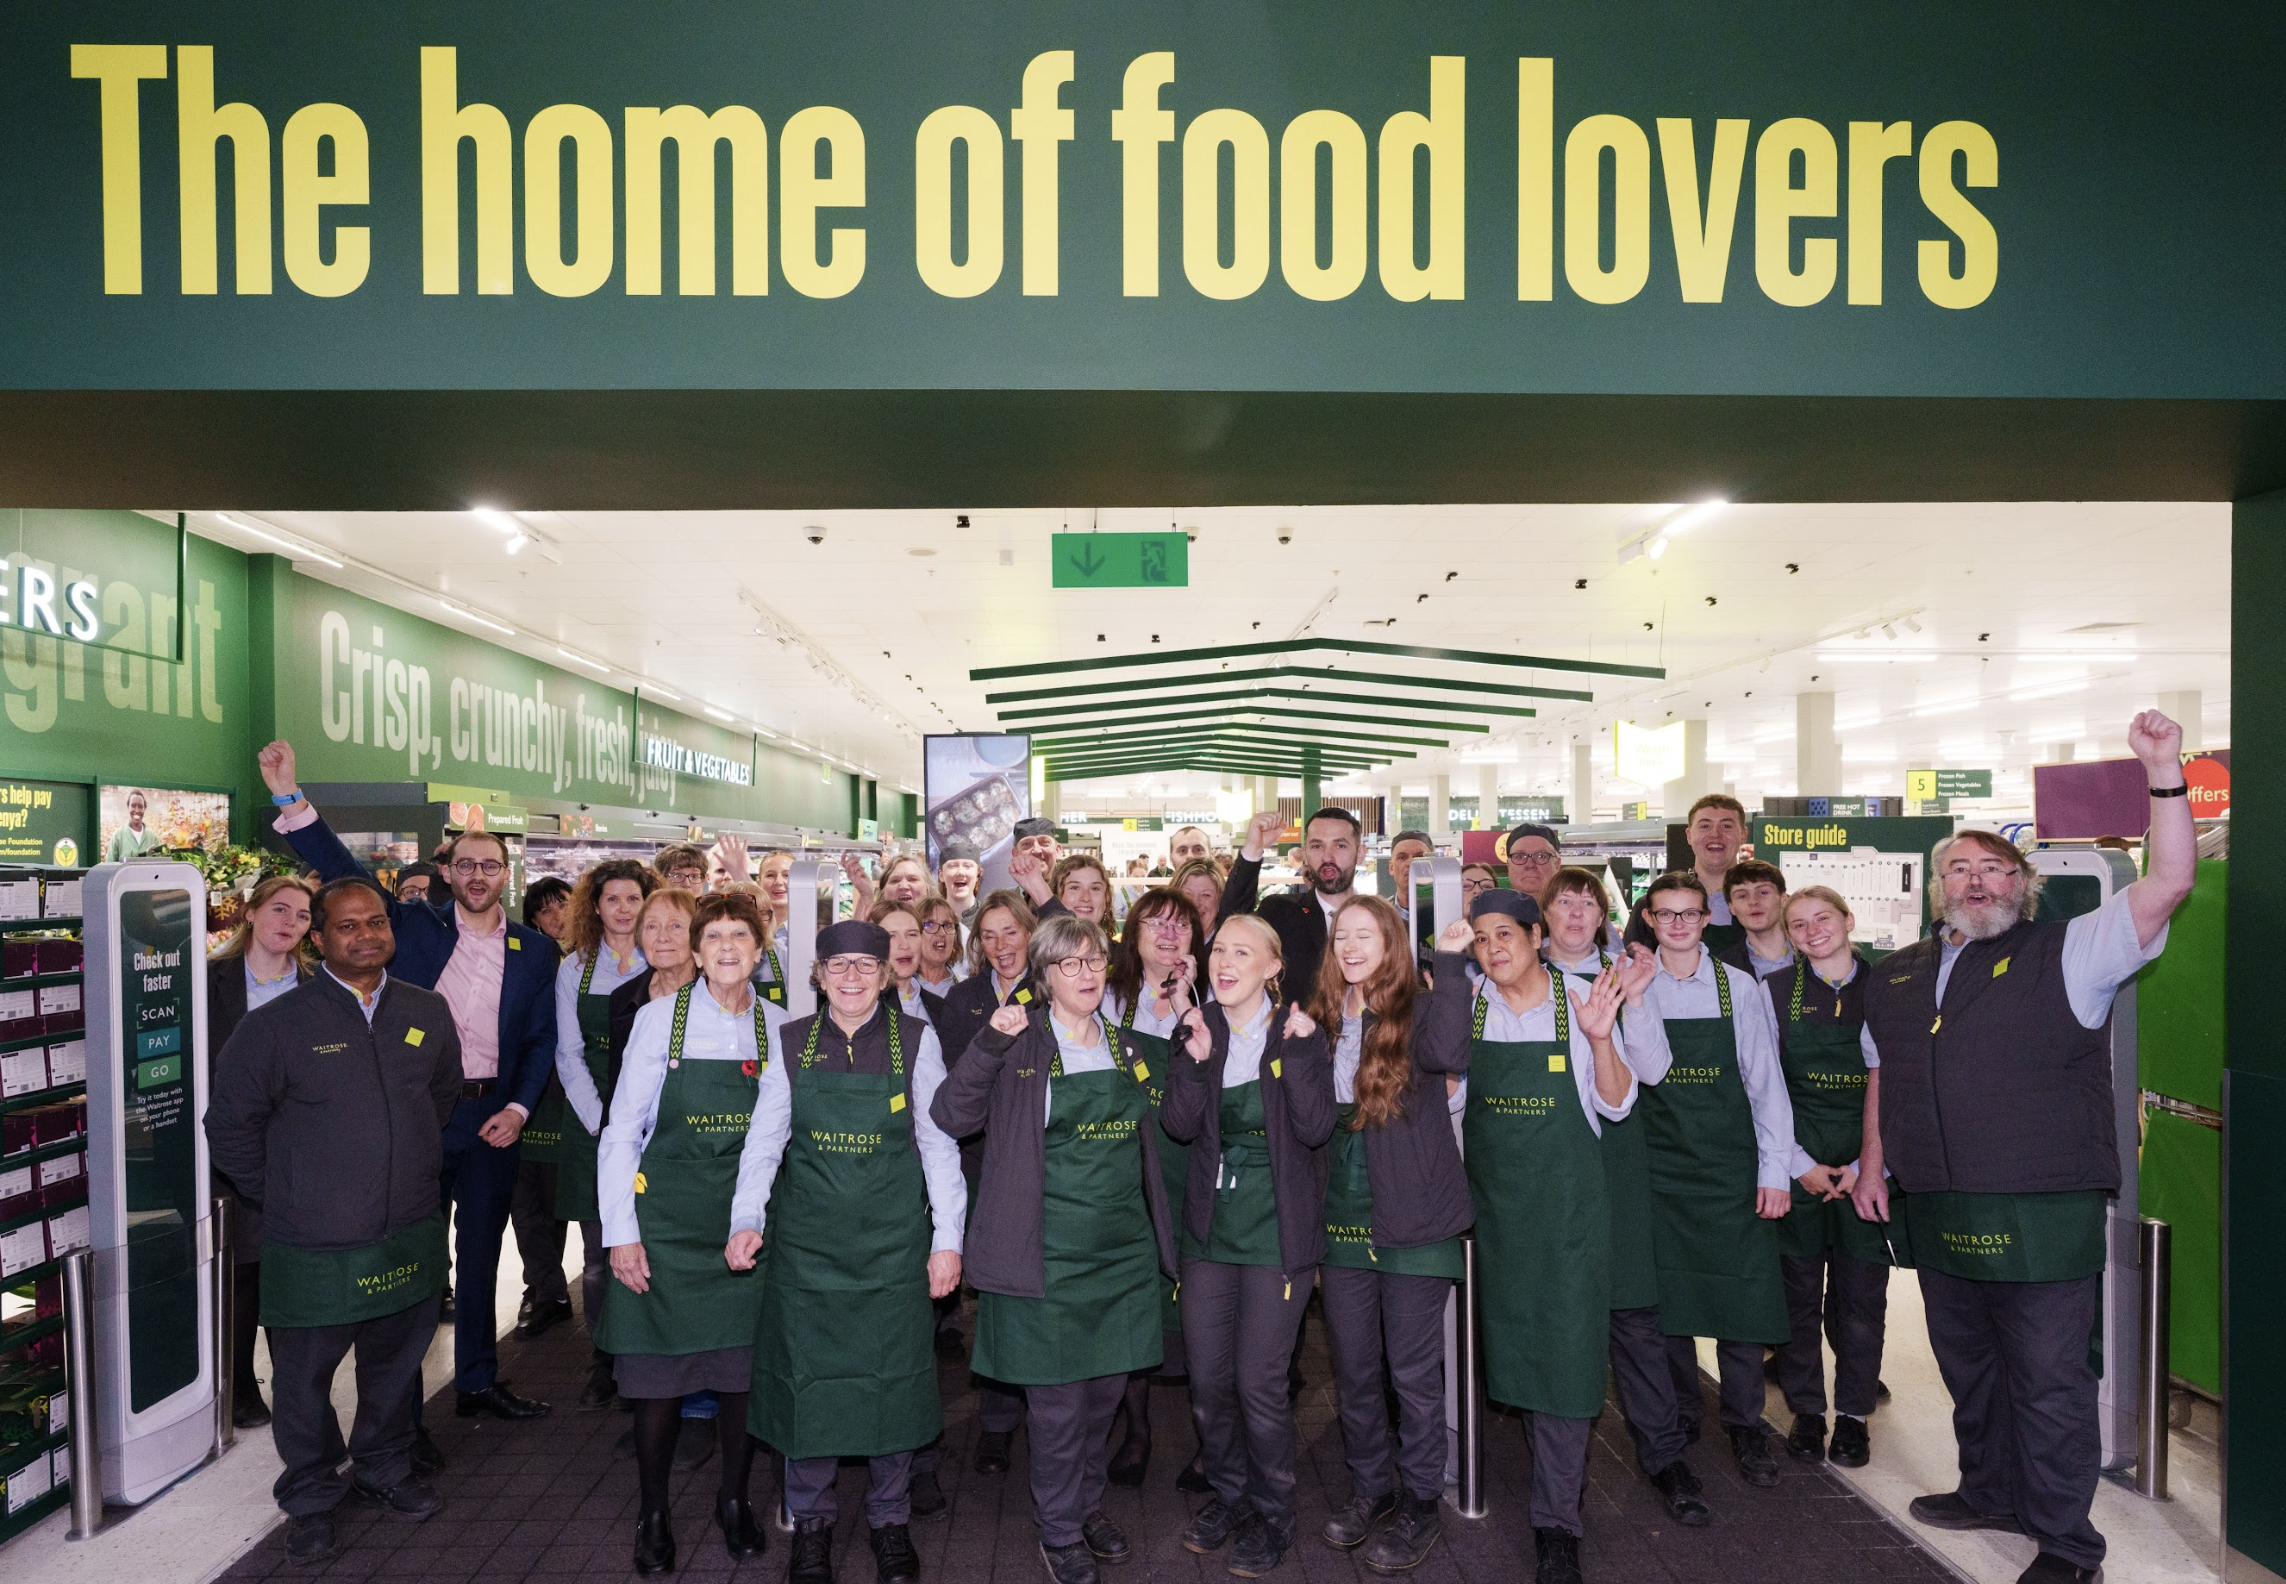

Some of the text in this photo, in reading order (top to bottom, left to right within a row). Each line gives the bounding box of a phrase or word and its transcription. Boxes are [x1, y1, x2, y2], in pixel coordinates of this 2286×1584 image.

[71, 45, 1997, 309] The home of food lovers
[320, 610, 441, 776] Crisp,
[450, 678, 571, 793] crunchy,
[575, 693, 635, 797] fresh,
[645, 738, 750, 786] FRUIT & VEGETABLES
[1917, 778, 1926, 791] 5
[9, 784, 32, 808] help
[33, 790, 52, 809] pay
[2187, 786, 2229, 803] ffers
[488, 812, 524, 826] Prepared Fruit
[8, 837, 43, 846] Foundation
[1764, 823, 1847, 849] Store guide
[133, 949, 181, 972] Check out
[142, 974, 172, 993] faster
[141, 1005, 175, 1021] SCAN
[148, 1035, 170, 1049] PAY
[312, 1043, 348, 1052] WAITROSE
[150, 1064, 169, 1078] GO
[1668, 1067, 1720, 1077] AITROSE
[1807, 1072, 1869, 1083] WAITROS
[137, 1096, 147, 1104] Try
[153, 1091, 169, 1100] today
[170, 1087, 183, 1095] with
[1485, 1096, 1555, 1107] WAITROSE
[147, 1100, 173, 1110] Waitrose
[173, 1097, 184, 1105] app
[149, 1112, 162, 1122] your
[162, 1108, 180, 1119] phone
[1503, 1107, 1546, 1116] PARTNERS
[155, 1117, 178, 1128] handset
[686, 1113, 751, 1125] WAITROS
[705, 1125, 749, 1133] PARTNERS
[1077, 1120, 1137, 1132] WAITROSE
[522, 1131, 562, 1140] AITROSE
[811, 1130, 882, 1144] WAITROSE
[1088, 1132, 1129, 1140] PARTNERS
[827, 1144, 873, 1154] PARTNERS
[1326, 1223, 1373, 1236] WAITRO
[1343, 1236, 1370, 1244] PARTN
[1941, 1231, 2012, 1246] WAITROSE
[1957, 1246, 2004, 1255] PARTNERS
